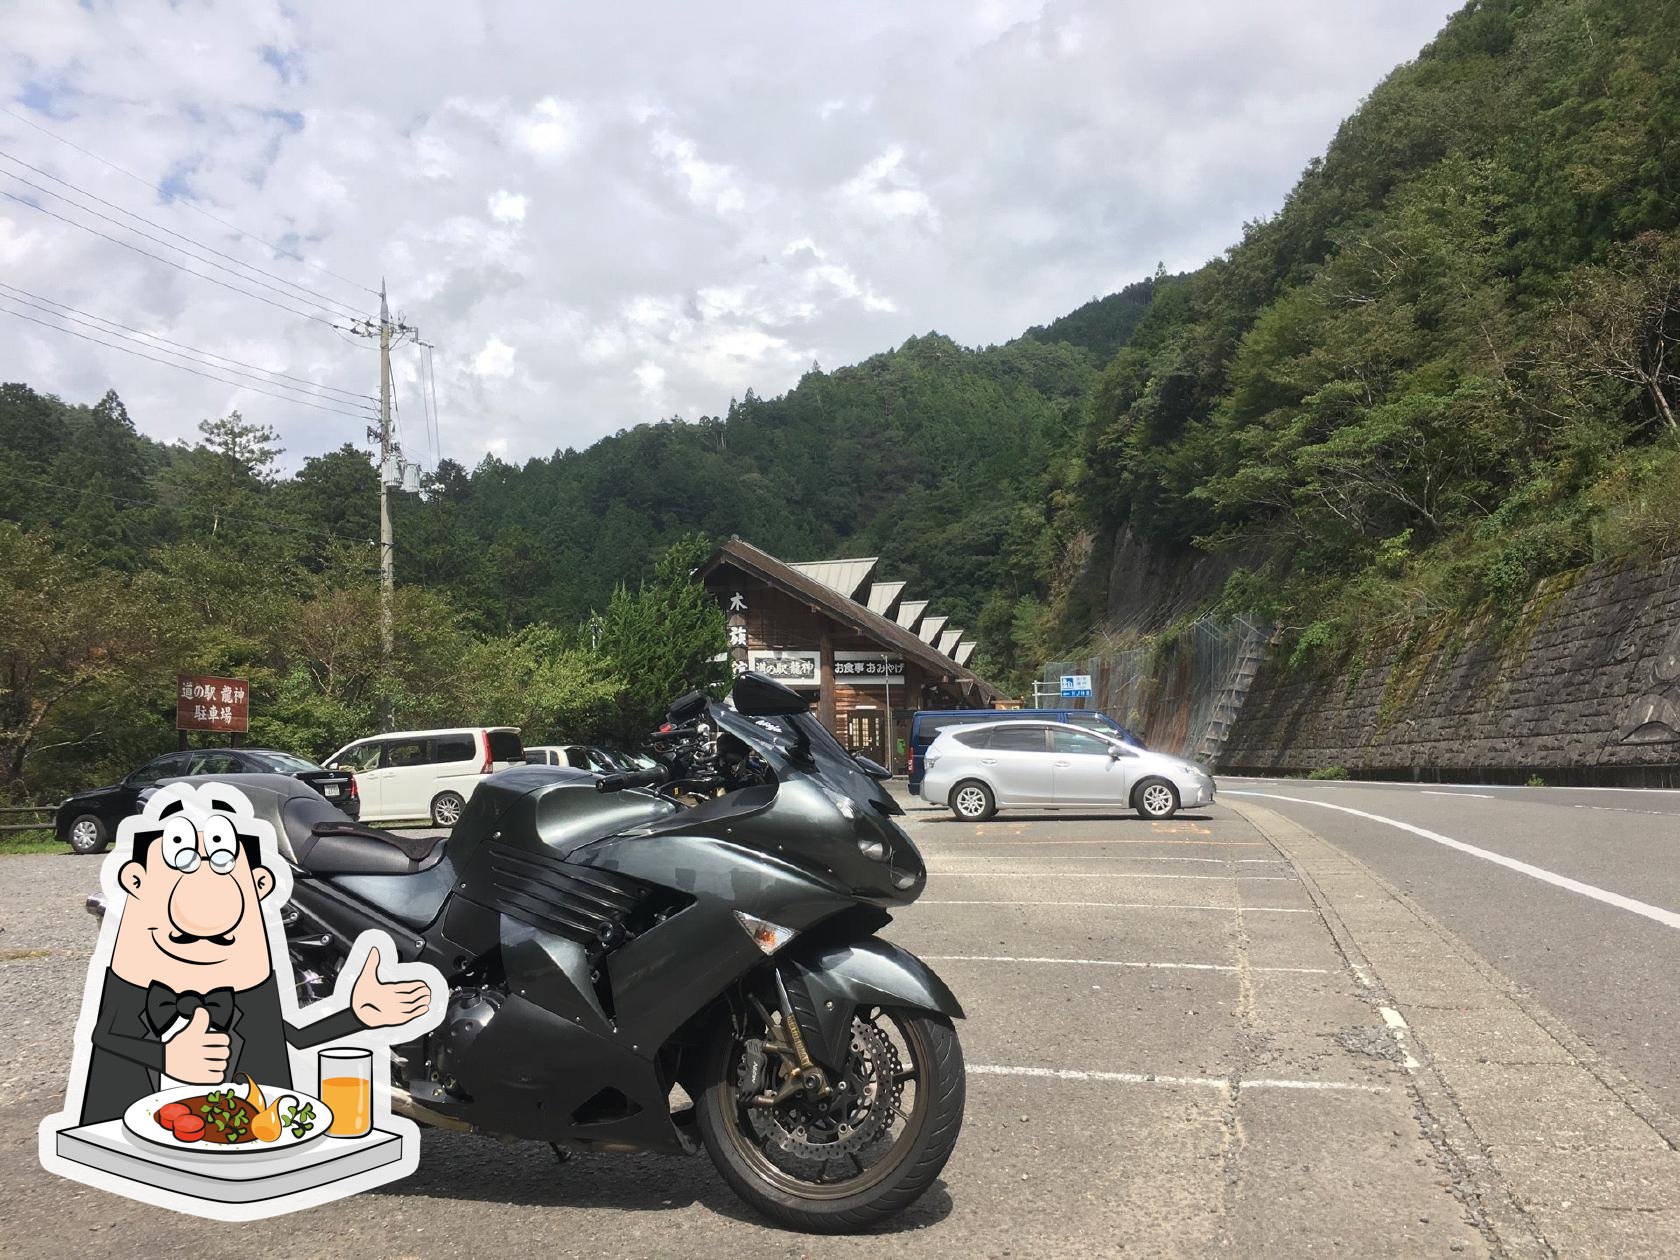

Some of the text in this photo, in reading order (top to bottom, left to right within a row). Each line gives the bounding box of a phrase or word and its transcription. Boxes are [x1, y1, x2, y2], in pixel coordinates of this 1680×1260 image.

[834, 662, 864, 674] お食事
[181, 682, 245, 704] 道の駅 龍神
[194, 705, 233, 725] 駐車場
